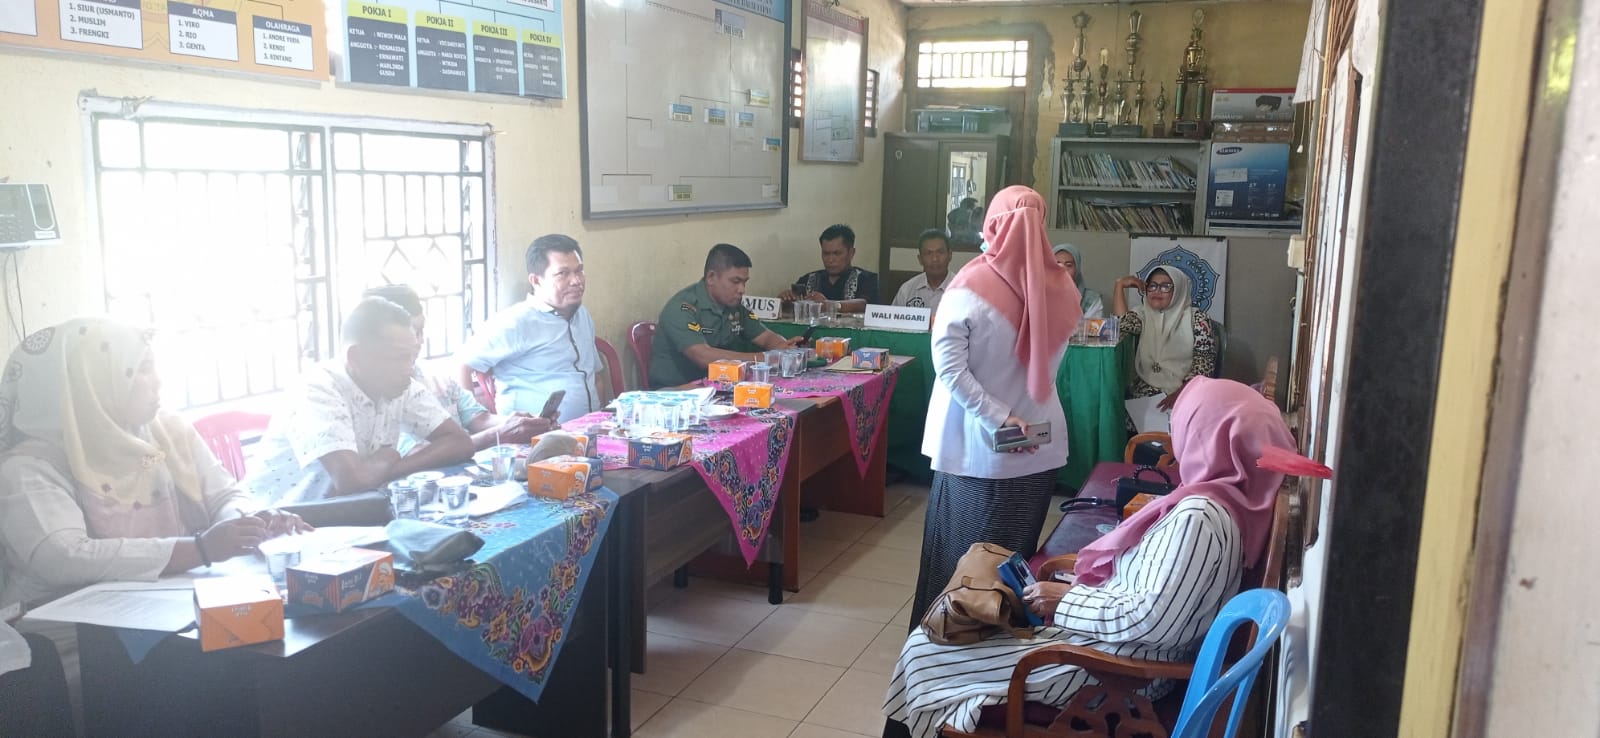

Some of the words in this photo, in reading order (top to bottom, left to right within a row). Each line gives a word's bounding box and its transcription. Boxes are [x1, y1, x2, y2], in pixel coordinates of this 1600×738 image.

[77, 4, 95, 13] SIUR
[96, 7, 135, 20] (USMANTO)
[192, 8, 215, 18] AQMA
[362, 5, 386, 17] POKJA
[388, 9, 392, 18] I
[69, 15, 76, 23] 2.
[78, 16, 106, 26] MUSLIM
[185, 20, 200, 29] VIRO
[426, 16, 445, 26] POKJA
[265, 21, 300, 33] OLAHRAGA
[480, 25, 499, 35] POKJA
[78, 28, 109, 39] FRENGKI
[529, 33, 545, 43] POKJA
[186, 42, 206, 52] GENTA
[742, 297, 775, 311] MUS
[871, 312, 892, 320] WALI
[893, 313, 925, 322] NAGARI
